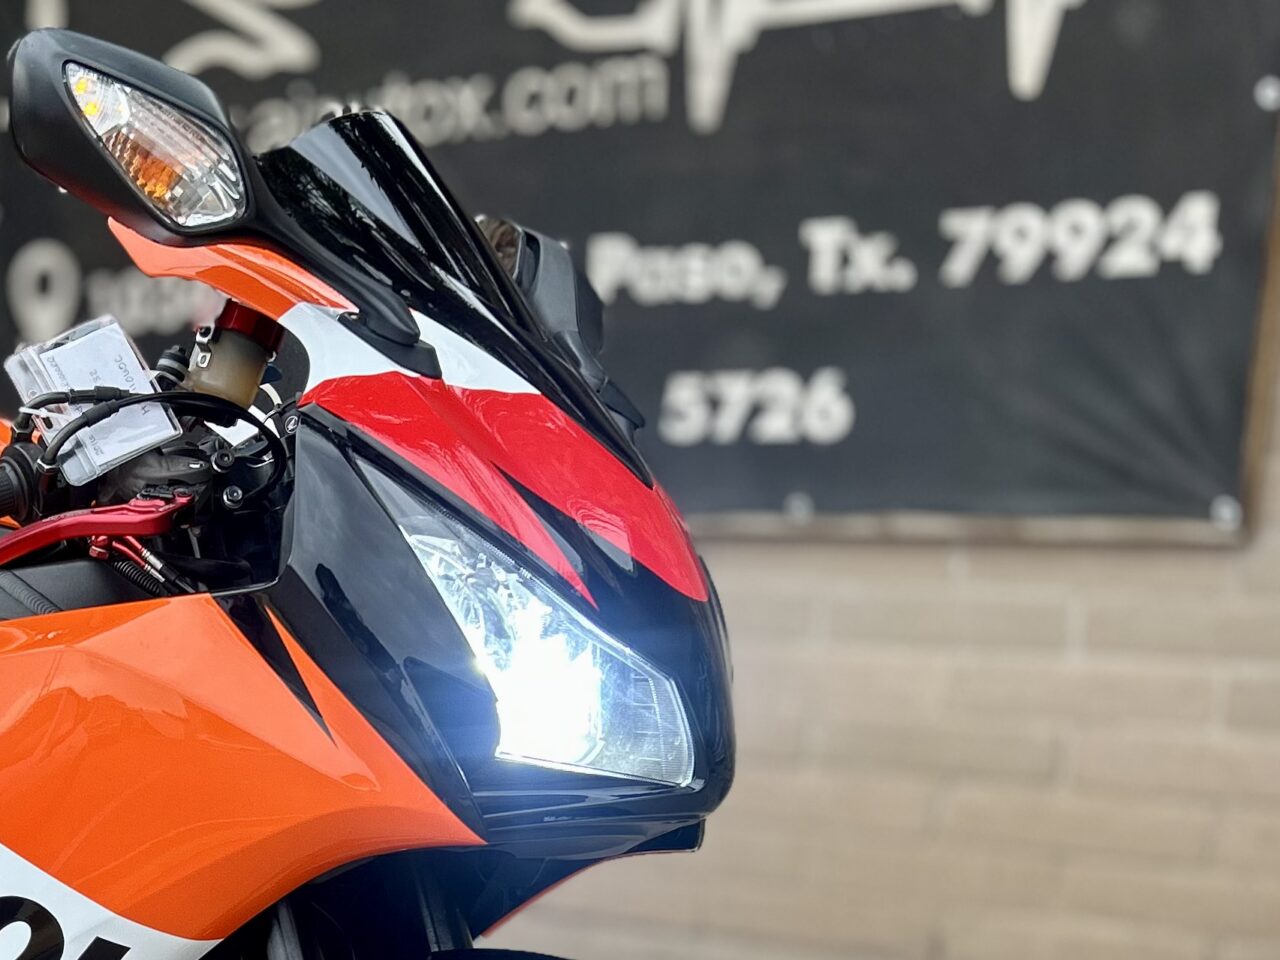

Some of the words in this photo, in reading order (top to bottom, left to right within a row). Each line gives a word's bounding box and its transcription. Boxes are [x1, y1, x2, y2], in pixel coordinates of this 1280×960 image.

[799, 216, 917, 295] Tx.
[938, 190, 1222, 287] 79924
[659, 367, 855, 446] 5726
